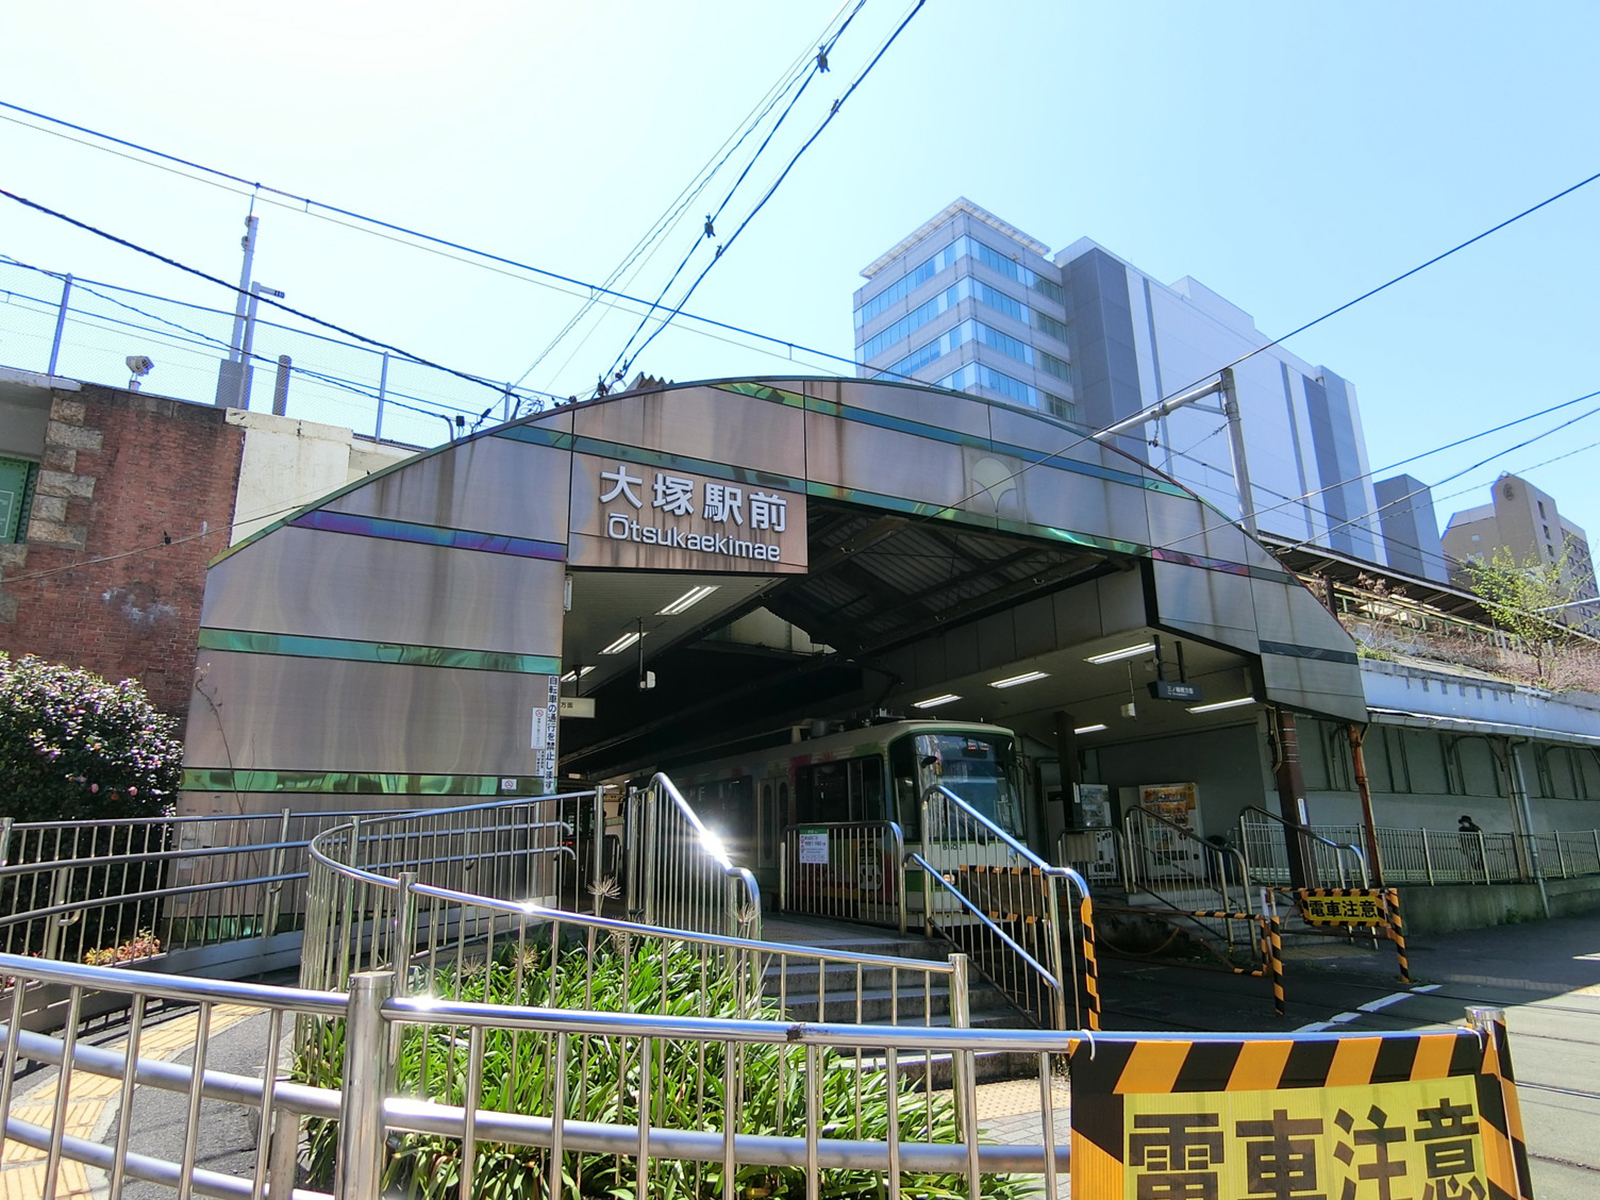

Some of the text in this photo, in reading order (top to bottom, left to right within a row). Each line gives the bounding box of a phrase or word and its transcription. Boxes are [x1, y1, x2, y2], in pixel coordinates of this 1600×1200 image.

[600, 465, 787, 532] 大塚駅前
[608, 512, 781, 562] Ōtsukaekimae
[1309, 900, 1378, 918] 電車注意
[1129, 1098, 1487, 1200] 電車注意
